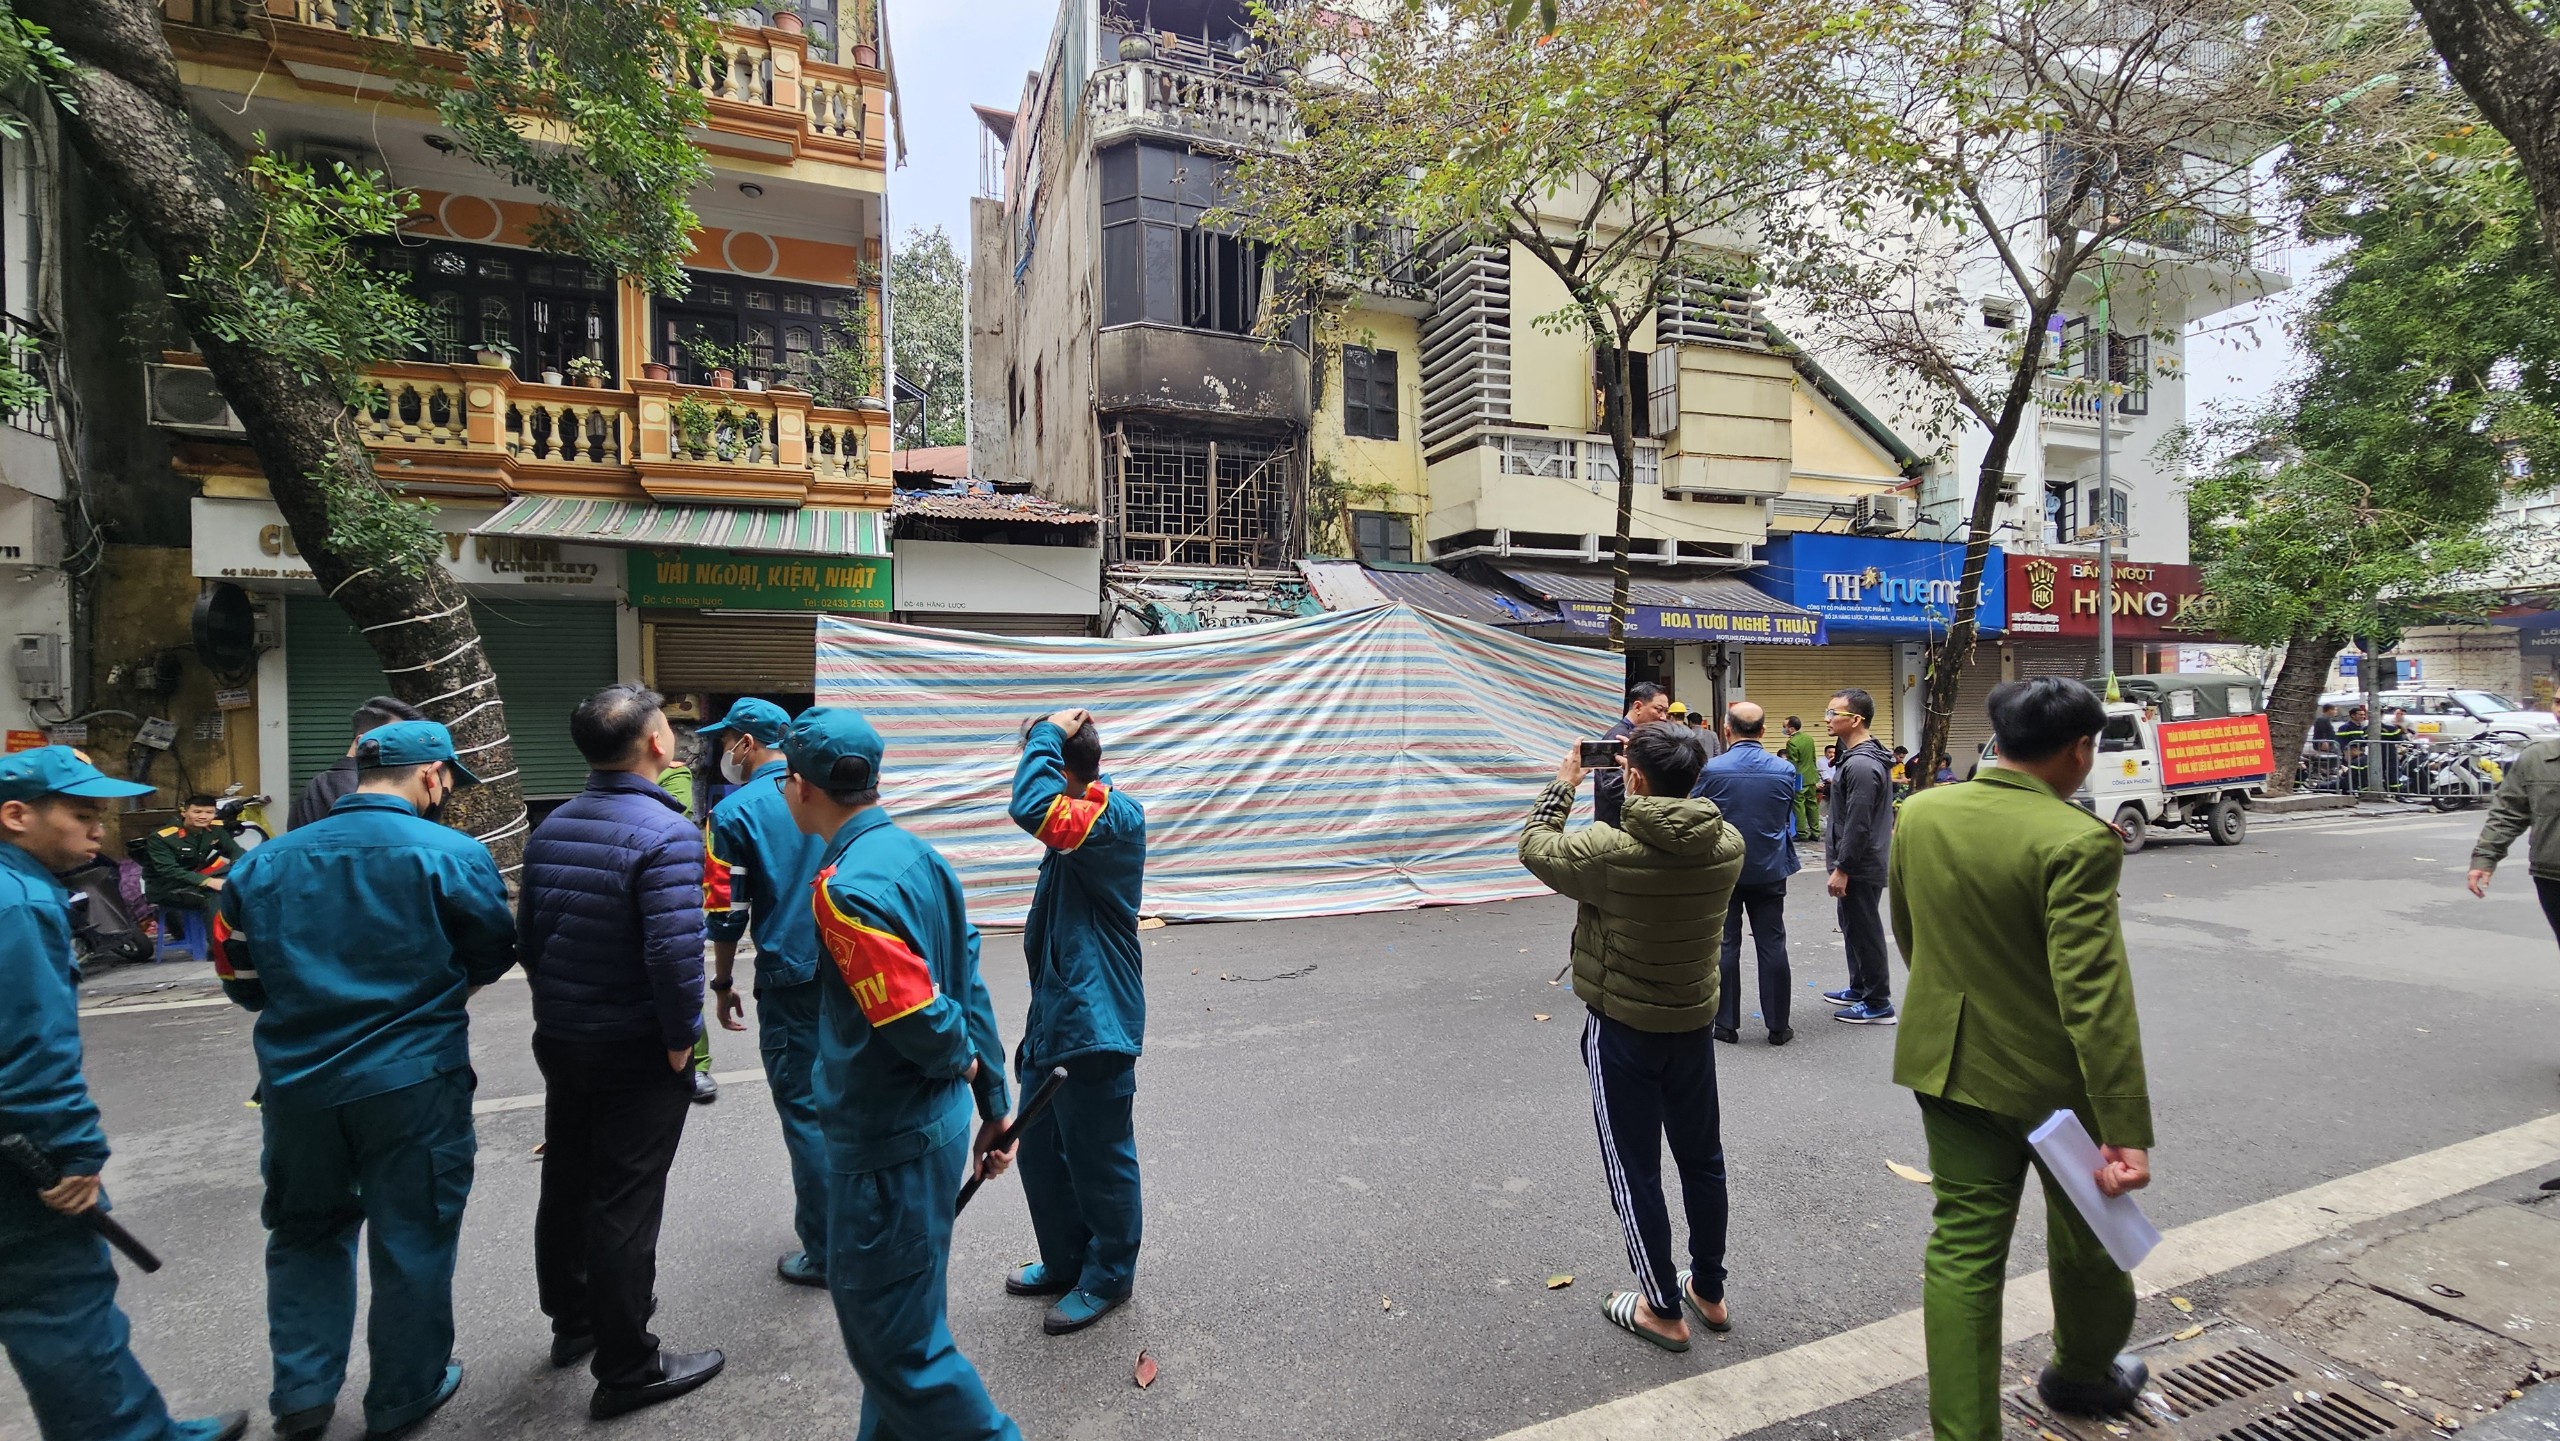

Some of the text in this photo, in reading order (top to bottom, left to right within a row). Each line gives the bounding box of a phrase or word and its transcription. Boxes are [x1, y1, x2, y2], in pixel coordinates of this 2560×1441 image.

[768, 561, 821, 593] KIỆN,
[825, 562, 877, 594] NHẬT
[2117, 566, 2155, 585] NGỌT
[1823, 573, 1862, 601] TH
[2035, 590, 2050, 604] HK
[851, 599, 867, 608] 251
[868, 599, 885, 609] 693
[1660, 612, 1817, 636] HOA TƯƠI NGHỆ THUẬT
